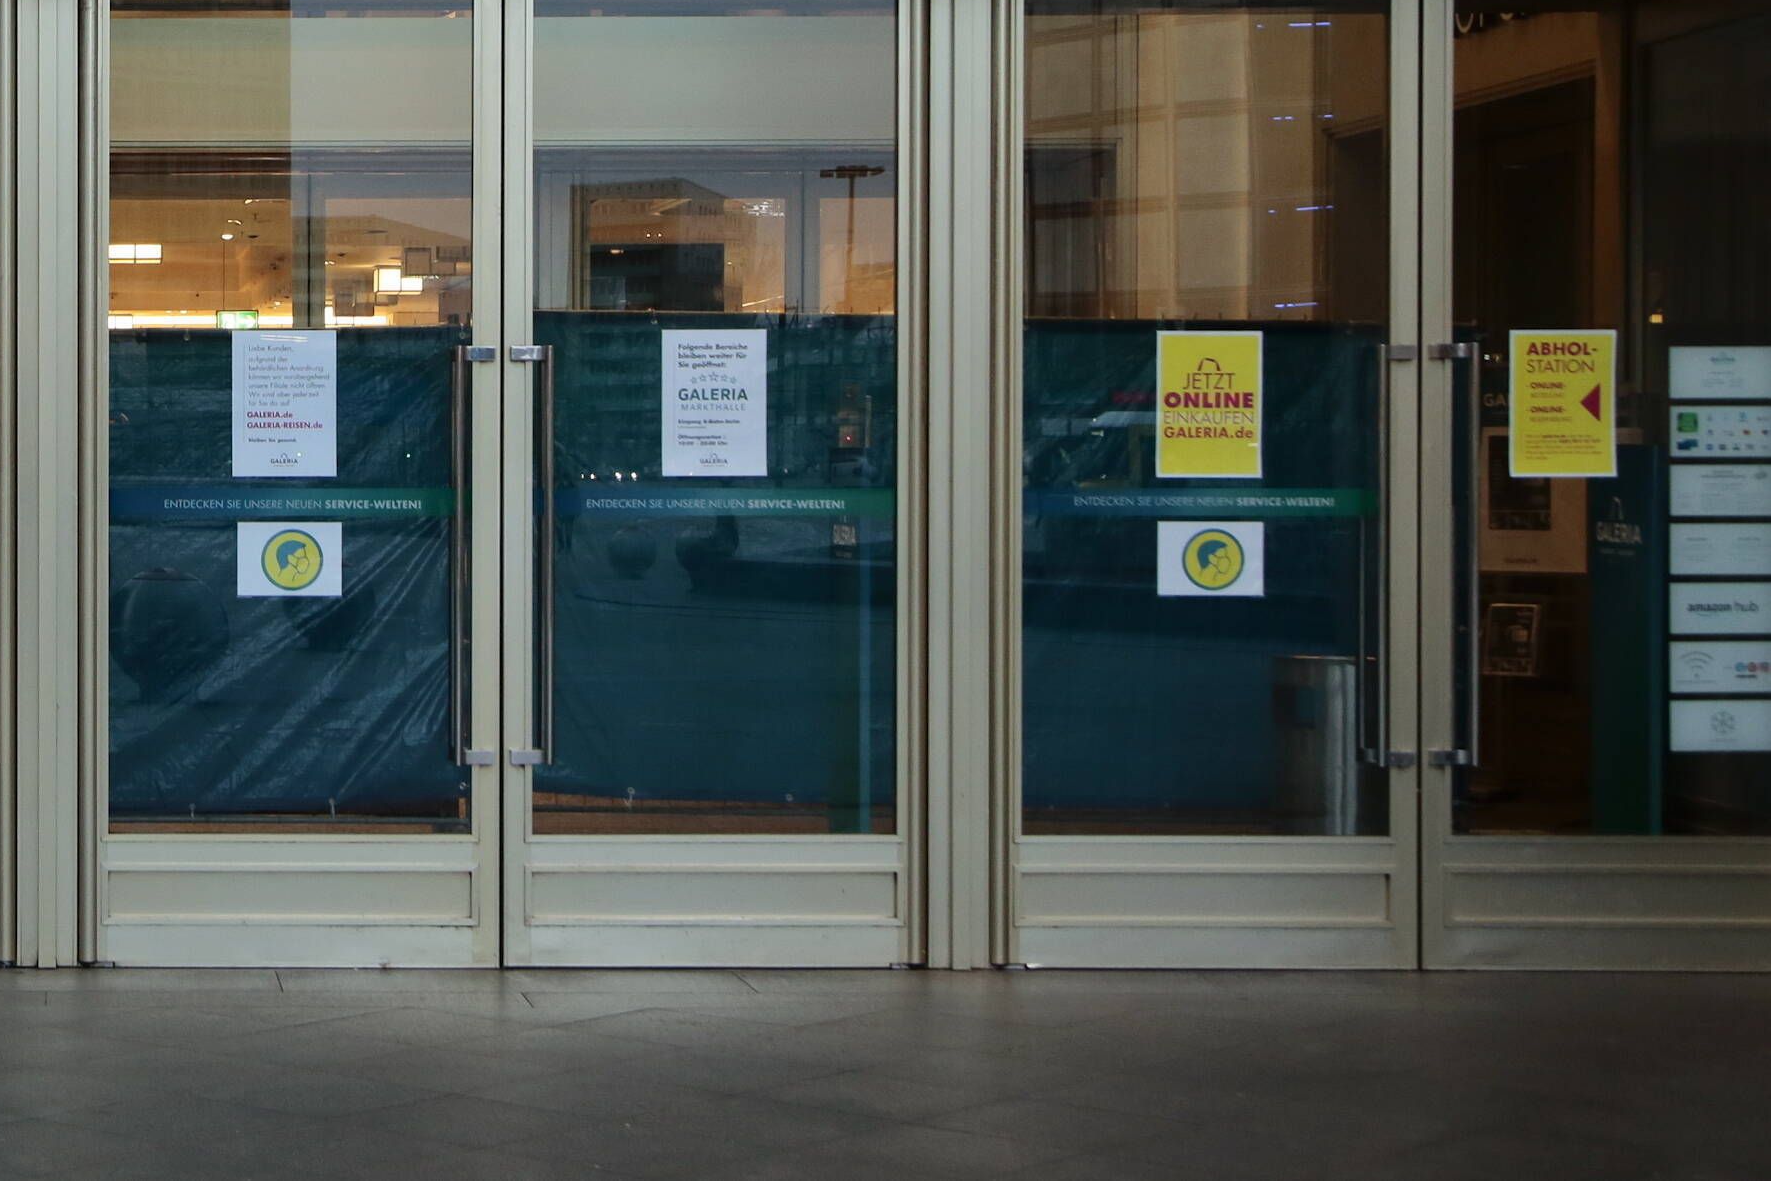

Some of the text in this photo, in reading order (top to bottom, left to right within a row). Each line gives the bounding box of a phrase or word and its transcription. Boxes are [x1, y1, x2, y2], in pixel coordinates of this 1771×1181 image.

[1526, 342, 1598, 355] ABHOL-
[1526, 359, 1594, 373] STATION
[1182, 373, 1236, 390] JETZT
[678, 388, 748, 401] GALERIA
[1164, 392, 1254, 409] ONLINE
[681, 403, 746, 411] MARKTHALLE
[246, 411, 294, 419] GALERIA.de
[1164, 411, 1254, 425] EINKAUFEN
[246, 421, 323, 429] GALERIA-REISEN.de
[1164, 426, 1253, 439] GALERIA.de
[164, 498, 422, 510] ENTDECKEN SIE UNSERE NEUEN SERVICE-WELTEN!
[586, 498, 845, 510] ENTDECKEN SIE UNSERE NEUEN SERVICE-WELTEN!
[1074, 496, 1335, 508] ENTDECKEN SIE UNSERE NEUEN SERVICE-WELTEN!
